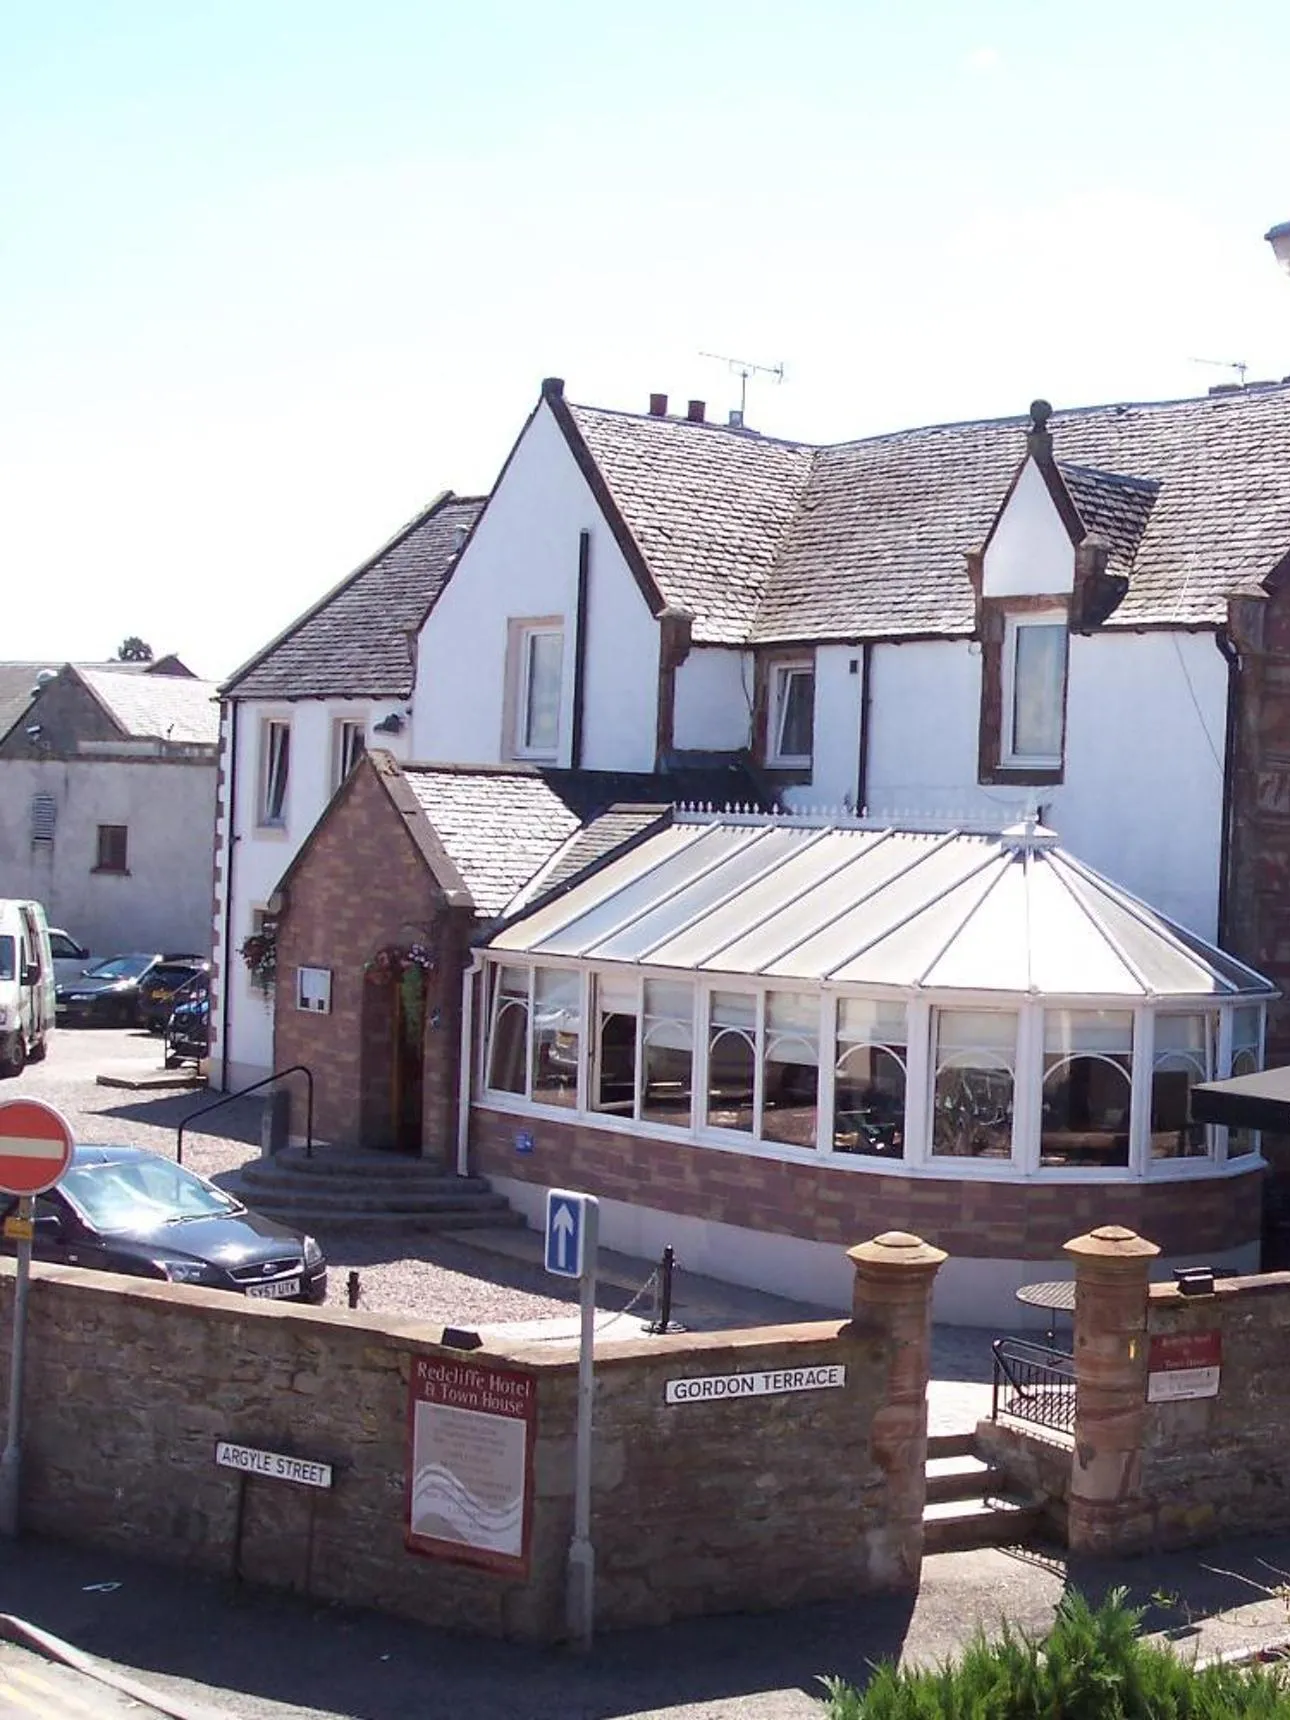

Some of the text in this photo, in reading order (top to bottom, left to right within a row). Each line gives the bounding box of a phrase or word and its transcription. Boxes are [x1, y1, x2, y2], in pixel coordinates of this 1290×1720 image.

[417, 1361, 530, 1398] Redcliffe Hotel
[674, 1369, 839, 1399] GORDON TERRACE
[440, 1383, 478, 1406] Town
[482, 1391, 524, 1414] House
[221, 1446, 326, 1483] ARGYLE STREET
